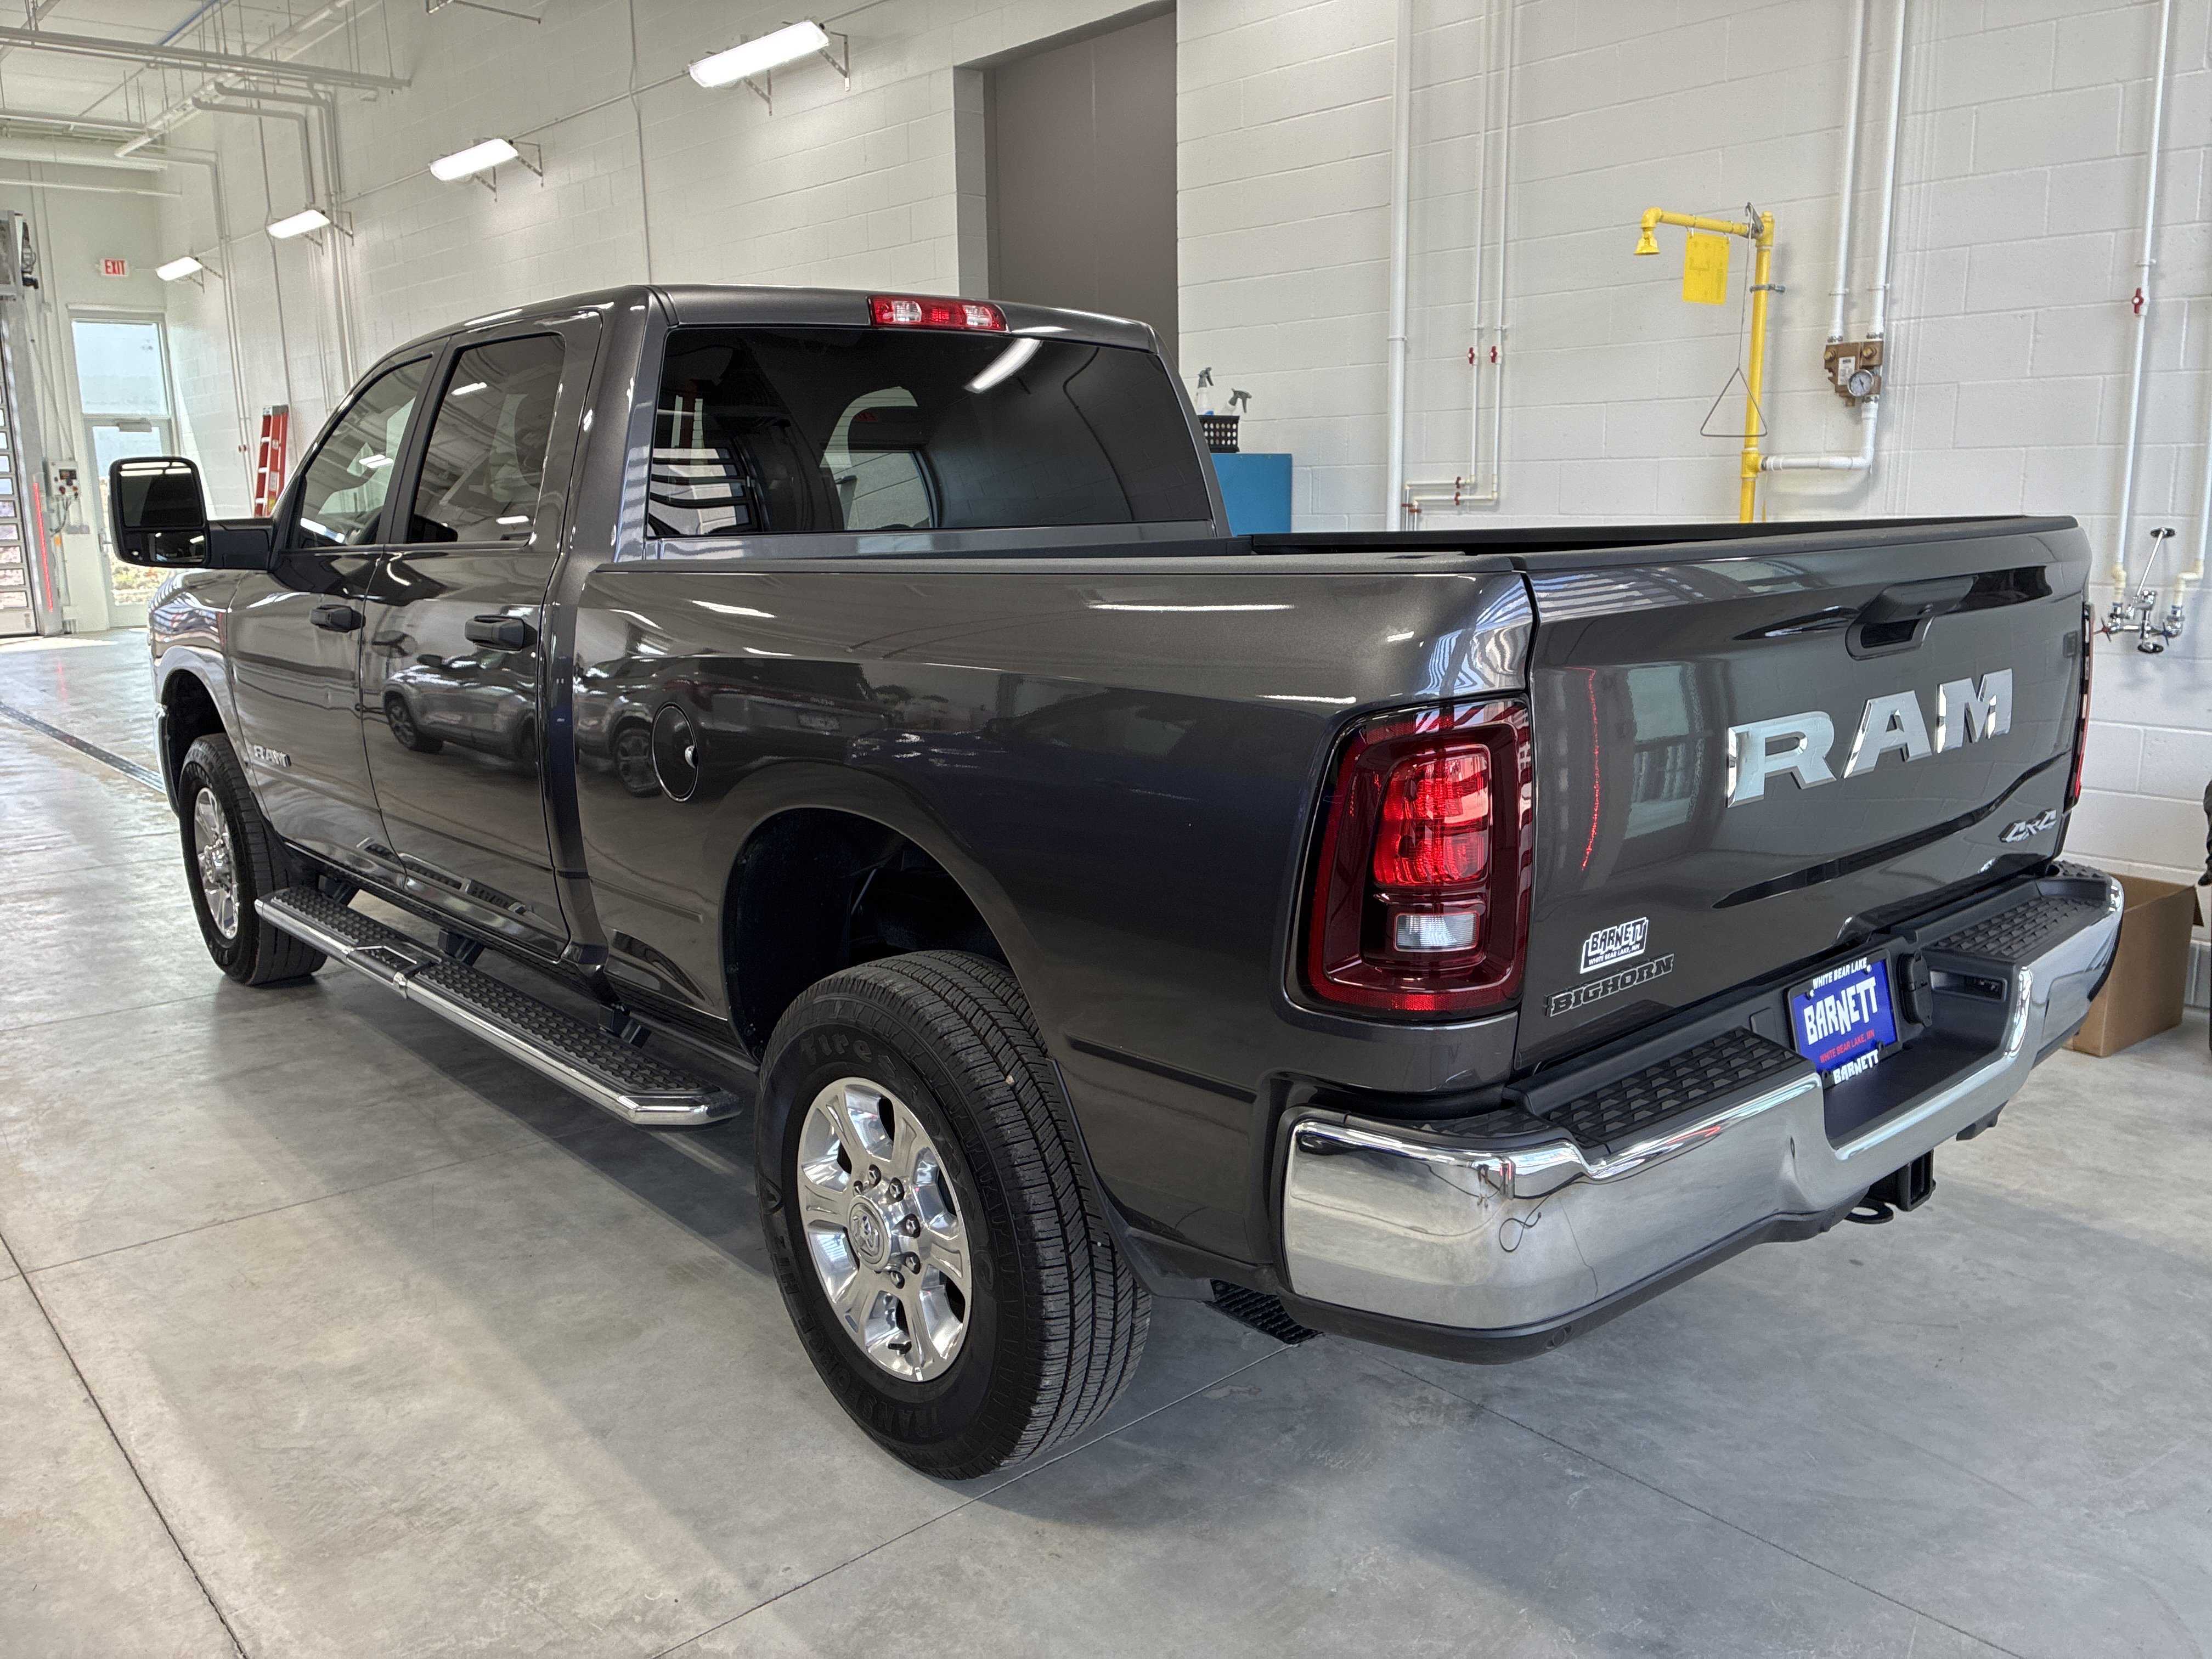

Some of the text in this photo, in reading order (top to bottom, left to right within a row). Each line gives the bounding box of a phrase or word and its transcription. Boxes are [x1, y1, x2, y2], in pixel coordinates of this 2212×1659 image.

[105, 259, 125, 275] EXIT
[253, 744, 291, 768] RAM
[1726, 668, 2013, 808] RAM
[1590, 917, 1646, 953] BARNETT
[1589, 955, 1604, 966] WHITE
[1605, 951, 1617, 960] BEAR
[1632, 943, 1640, 951] MN
[1547, 953, 1674, 1017] BIGHORN
[1813, 957, 1867, 990] WHITE BEAR LAKE
[1803, 976, 1878, 1045] BARNETT
[1820, 1048, 1836, 1063] WHITE
[1836, 1040, 1851, 1055] BEAR
[1833, 1049, 1878, 1085] BARNETT
[797, 1313, 943, 1438] TRANSFORCE
